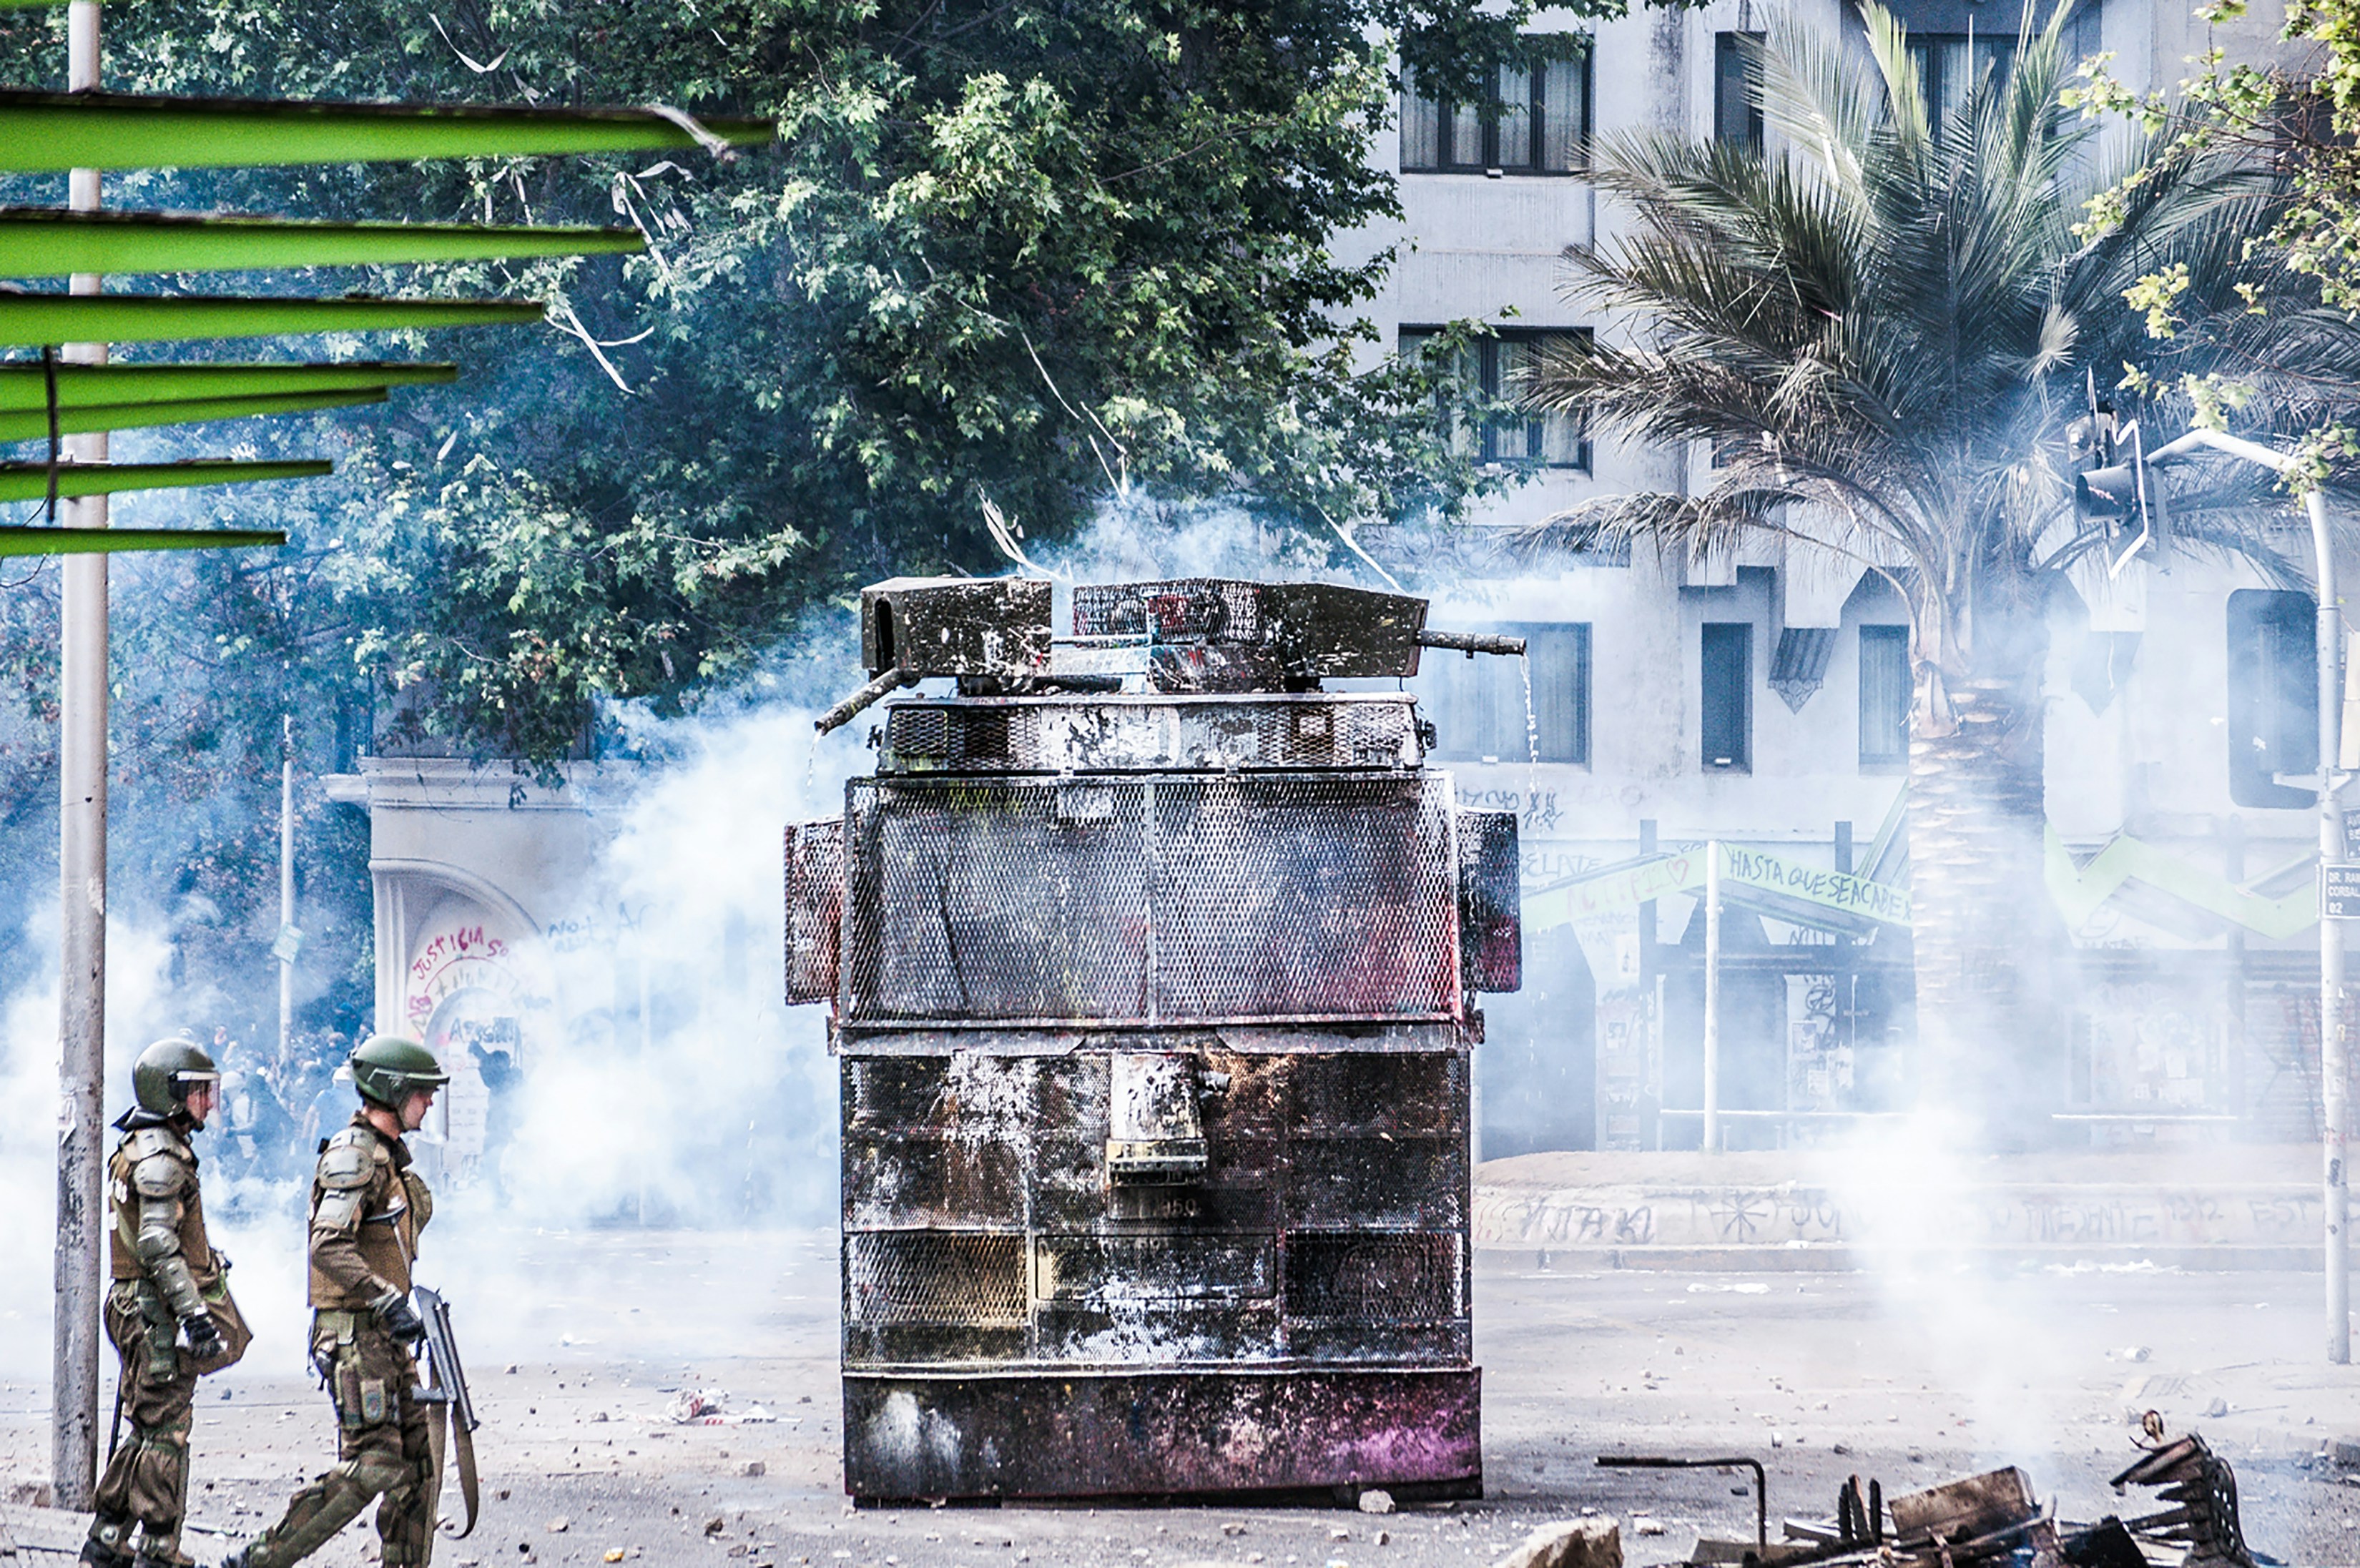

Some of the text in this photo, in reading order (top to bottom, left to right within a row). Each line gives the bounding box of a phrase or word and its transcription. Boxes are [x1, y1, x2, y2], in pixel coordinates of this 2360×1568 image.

[1729, 849, 1784, 884] HASTA
[2329, 902, 2344, 914] 02
[411, 925, 485, 980] JUSTICIA
